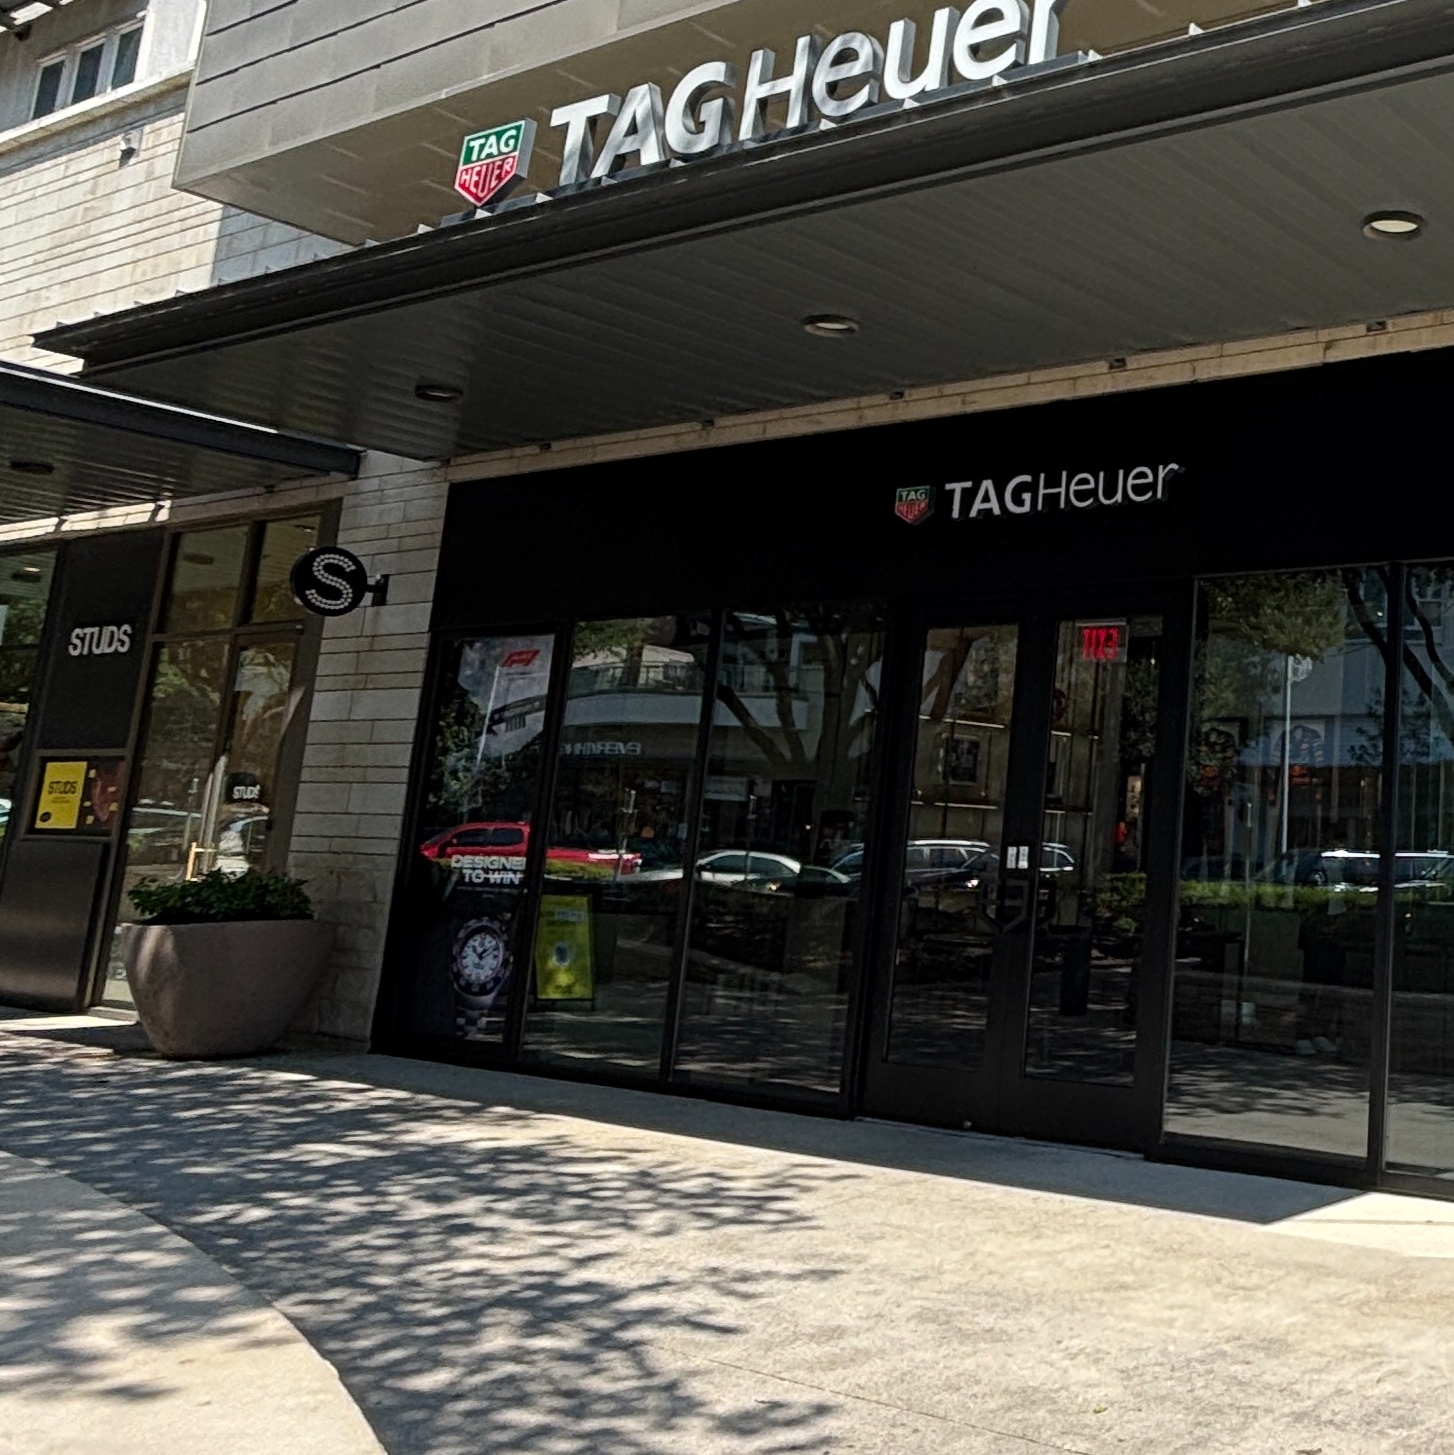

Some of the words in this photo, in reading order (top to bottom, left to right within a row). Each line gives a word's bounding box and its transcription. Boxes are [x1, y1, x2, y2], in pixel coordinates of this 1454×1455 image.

[469, 129, 517, 161] TAG
[460, 157, 514, 198] HEUER
[901, 488, 926, 502] TAG
[305, 554, 356, 610] S
[68, 624, 132, 656] STUDS
[462, 869, 485, 884] TO
